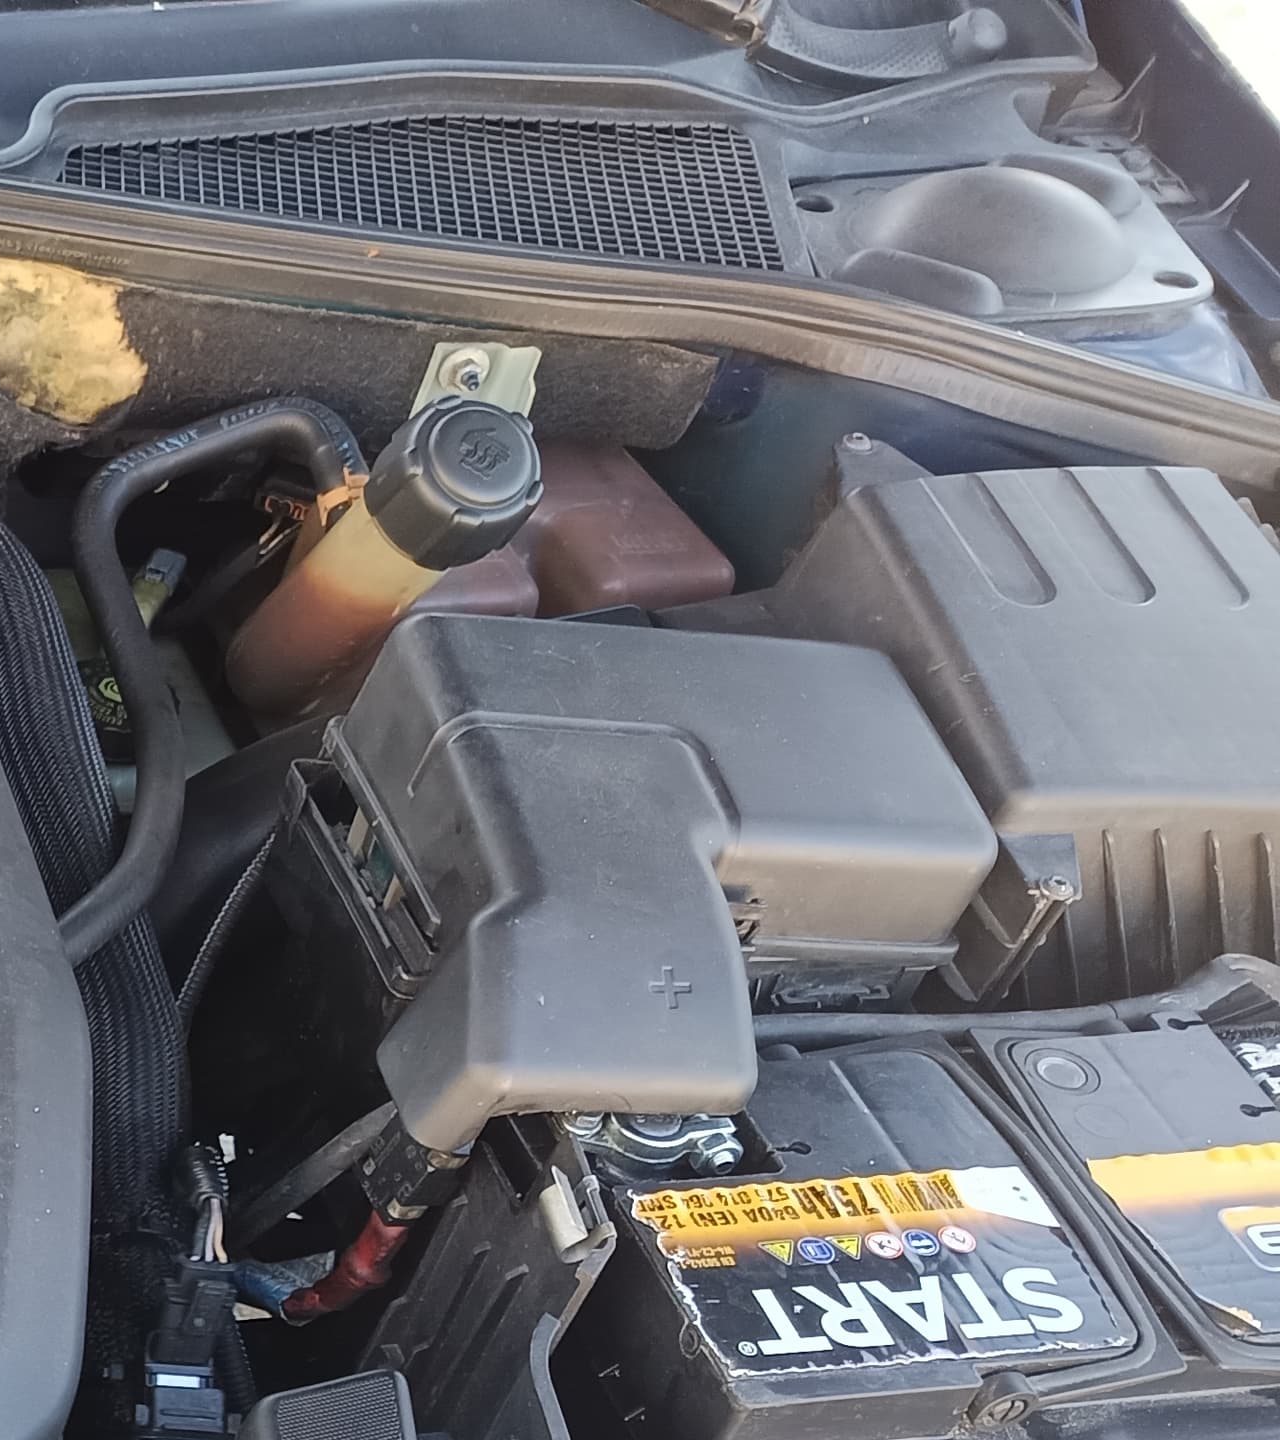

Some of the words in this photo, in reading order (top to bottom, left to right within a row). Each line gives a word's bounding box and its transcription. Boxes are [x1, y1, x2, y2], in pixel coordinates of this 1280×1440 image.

[743, 1206, 800, 1223] 640A
[796, 1182, 879, 1221] 75Ah
[693, 1211, 739, 1227] (EN)
[754, 1268, 1085, 1357] START
